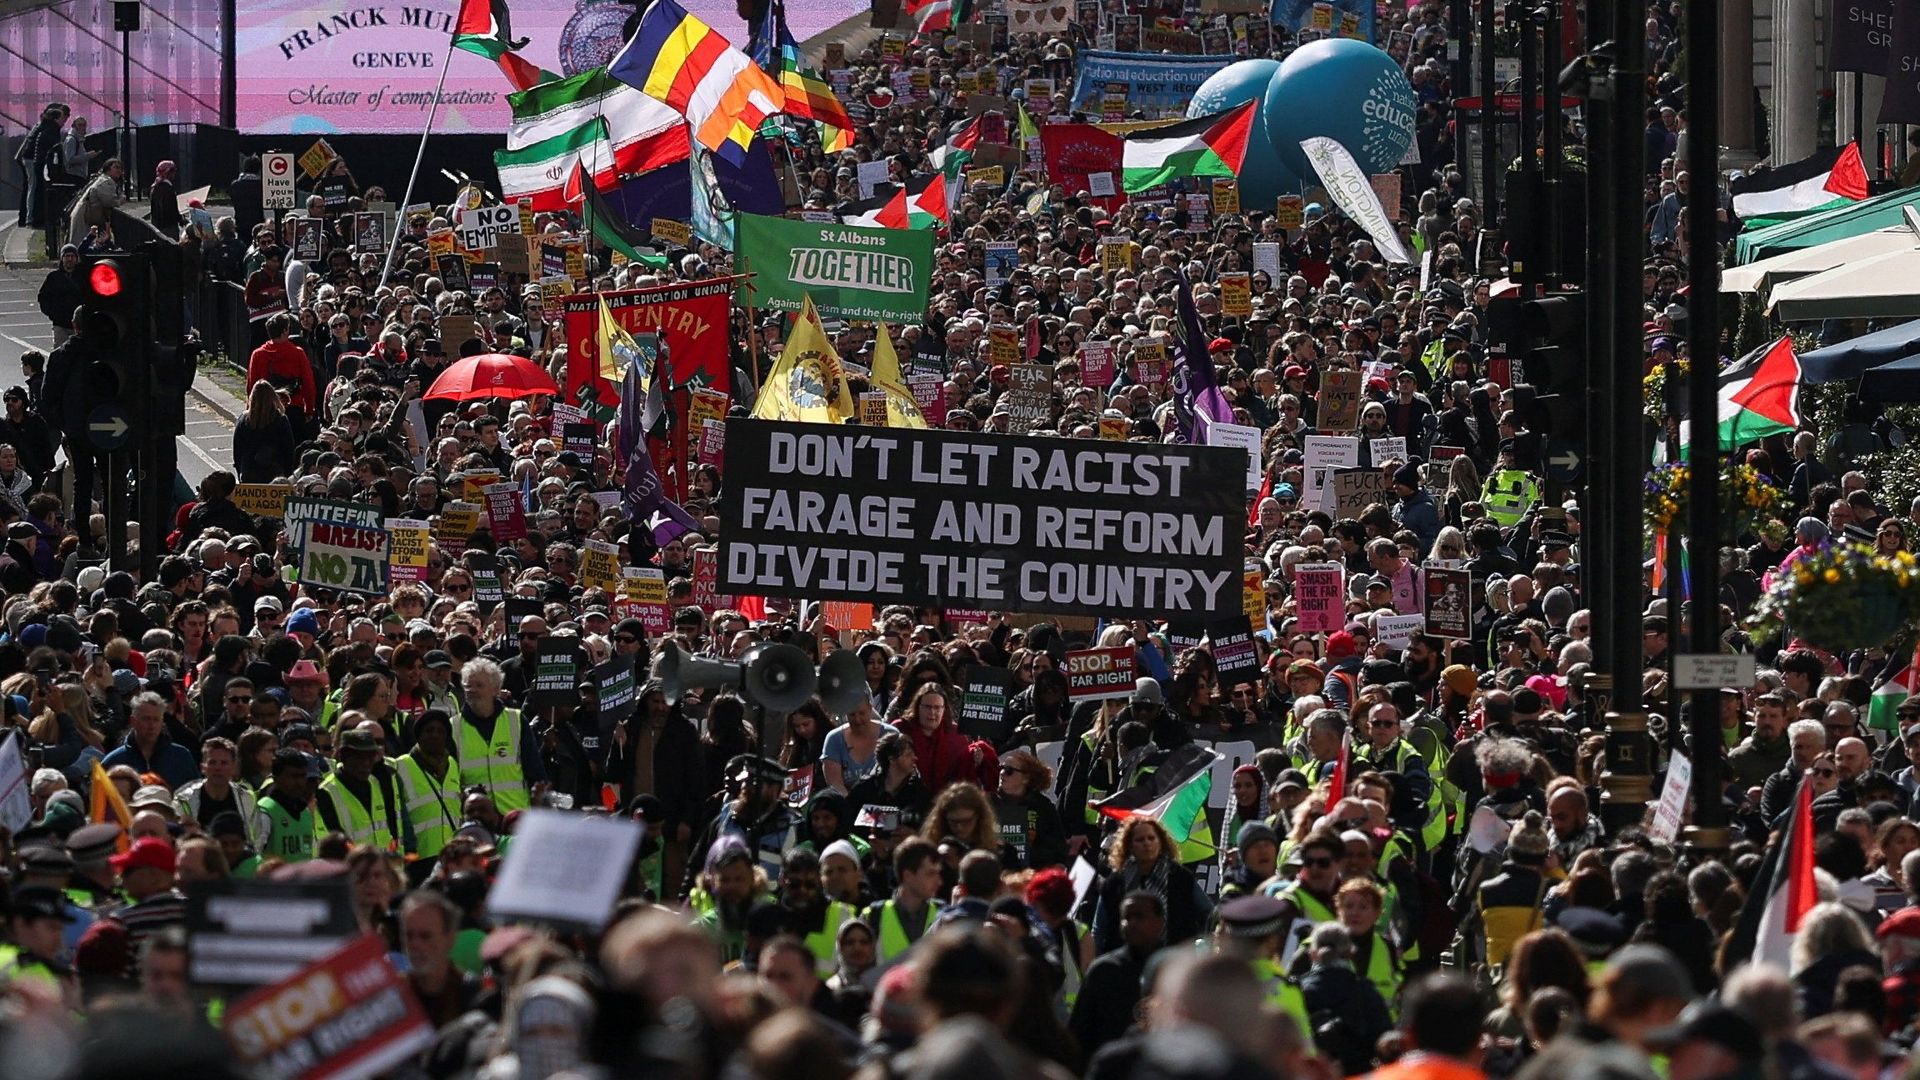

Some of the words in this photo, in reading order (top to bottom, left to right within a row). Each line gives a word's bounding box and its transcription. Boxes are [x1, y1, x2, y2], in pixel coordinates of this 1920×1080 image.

[278, 7, 387, 61] FRANCK
[353, 52, 434, 68] GENEVE
[1084, 65, 1128, 80] national
[1131, 68, 1188, 82] education
[288, 84, 361, 105] Master
[367, 85, 390, 111] of
[391, 88, 497, 111] complications
[267, 178, 290, 187] Have
[270, 189, 287, 197] you
[477, 208, 512, 226] NO
[654, 219, 675, 231] HANDS
[465, 222, 520, 249] EMPIRE
[820, 230, 834, 242] St
[836, 231, 886, 246] Albans
[790, 249, 913, 292] TOGETHER
[568, 298, 627, 312] NATINAL
[634, 288, 687, 305] EDUCATION
[694, 284, 728, 297] UNION
[841, 307, 861, 316] and
[862, 308, 879, 318] the
[882, 310, 923, 322] far-right
[1011, 367, 1048, 382] FEAR
[1139, 369, 1148, 377] TO
[1327, 391, 1355, 400] HATE
[554, 411, 581, 424] WOMEN
[1008, 405, 1051, 418] COURAGE
[579, 437, 592, 445] ARE
[769, 431, 898, 481] DON'T
[912, 439, 999, 486] LET
[1013, 447, 1190, 498] RACIST
[1343, 472, 1384, 491] FUCK
[234, 484, 267, 498] HANDS
[270, 485, 289, 497] OFF
[489, 493, 511, 501] WOMEN
[241, 499, 282, 510] AL-AQSA
[491, 499, 516, 508] AGAINST
[442, 512, 470, 521] Oppose
[493, 514, 510, 522] RIGHT
[742, 487, 916, 540] FARAGE
[930, 501, 1021, 546] AND
[1036, 506, 1225, 557] REFORM
[312, 523, 387, 552] NAZIS?
[394, 530, 419, 538] STOP
[391, 538, 423, 547] RACIST
[393, 546, 424, 556] EFORM
[592, 552, 609, 561] STOP
[398, 556, 412, 565] UK
[308, 551, 348, 584] NO
[473, 570, 482, 578] WE
[482, 570, 495, 578] ARE
[727, 541, 904, 594] DIVIDE
[920, 553, 1005, 601] THE
[1020, 560, 1233, 613] COUNTRY
[1300, 573, 1333, 585] SMASH
[627, 580, 664, 590] Refugees
[629, 591, 663, 600] welcome
[1301, 586, 1318, 597] THE
[1319, 586, 1338, 597] FAR
[630, 604, 648, 615] Stop
[649, 605, 663, 614] the
[1301, 598, 1329, 610] RIGHT
[961, 608, 972, 616] far
[972, 609, 986, 618] right
[644, 615, 663, 626] right
[1171, 635, 1184, 643] WE
[1185, 638, 1199, 646] ARE
[1215, 638, 1228, 647] WE
[1231, 633, 1248, 644] ARE
[541, 654, 553, 663] WE
[554, 654, 572, 663] ARE
[1216, 653, 1243, 664] AGAINST
[1243, 651, 1255, 659] THE
[1070, 655, 1110, 673] STOP
[1115, 658, 1132, 668] THE
[1218, 662, 1233, 672] FAR
[1234, 658, 1256, 669] RIGHT
[562, 674, 575, 682] THE
[601, 677, 614, 688] WE
[615, 669, 630, 682] ARE
[1071, 675, 1094, 687] FAR
[1097, 671, 1133, 685] RIGHT
[550, 682, 574, 690] RIGHT
[969, 683, 982, 694] WE
[983, 684, 1003, 695] ARE
[601, 701, 614, 712] FAR
[614, 697, 633, 710] RIGHT
[963, 704, 989, 713] AGAINST
[990, 706, 1004, 714] THE
[962, 710, 979, 720] FAR
[979, 710, 1003, 722] RIGHT
[797, 775, 810, 786] THE
[1002, 824, 1022, 833] ARE
